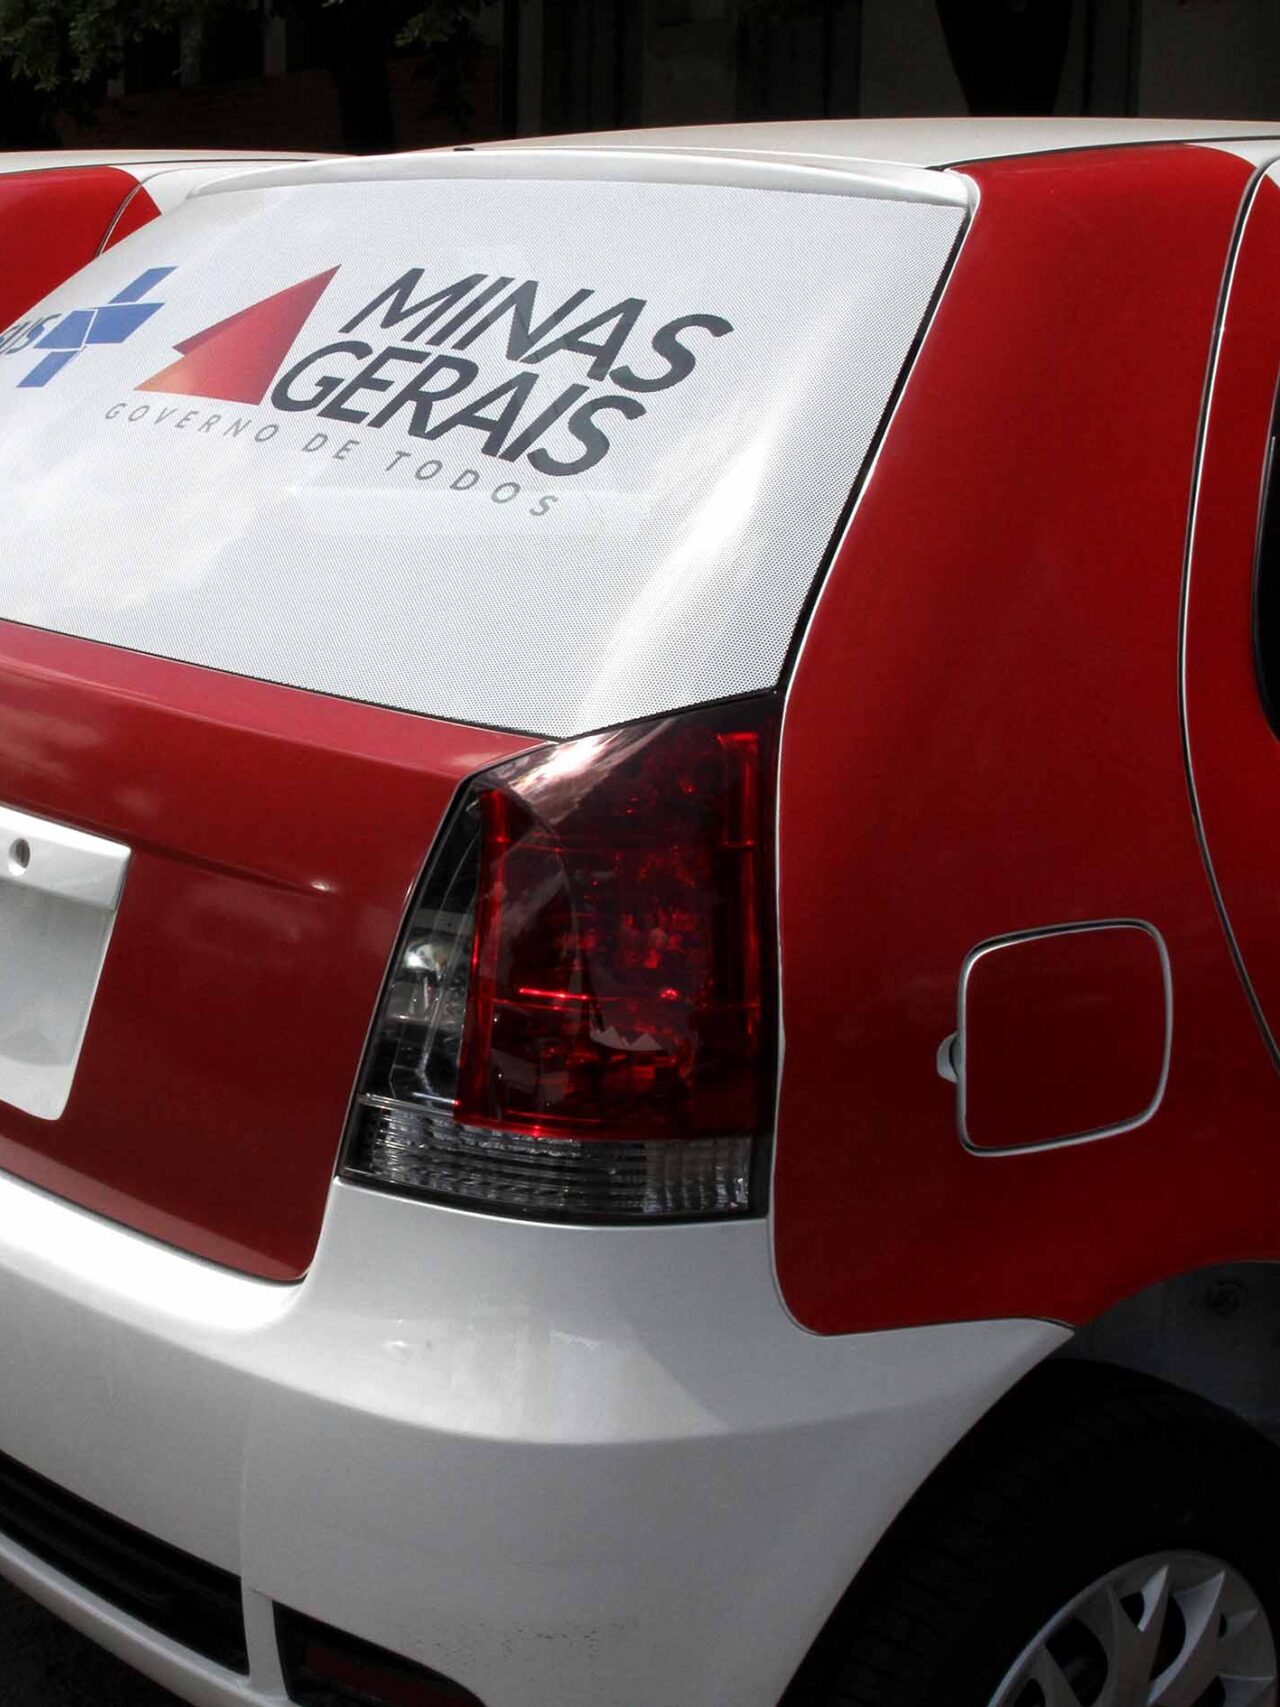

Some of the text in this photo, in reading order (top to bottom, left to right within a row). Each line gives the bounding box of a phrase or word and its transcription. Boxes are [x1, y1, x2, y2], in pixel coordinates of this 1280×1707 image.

[340, 267, 735, 393] MINAS
[104, 402, 561, 518] GOVERNO DE TODOS
[270, 338, 648, 478] GERAIS
